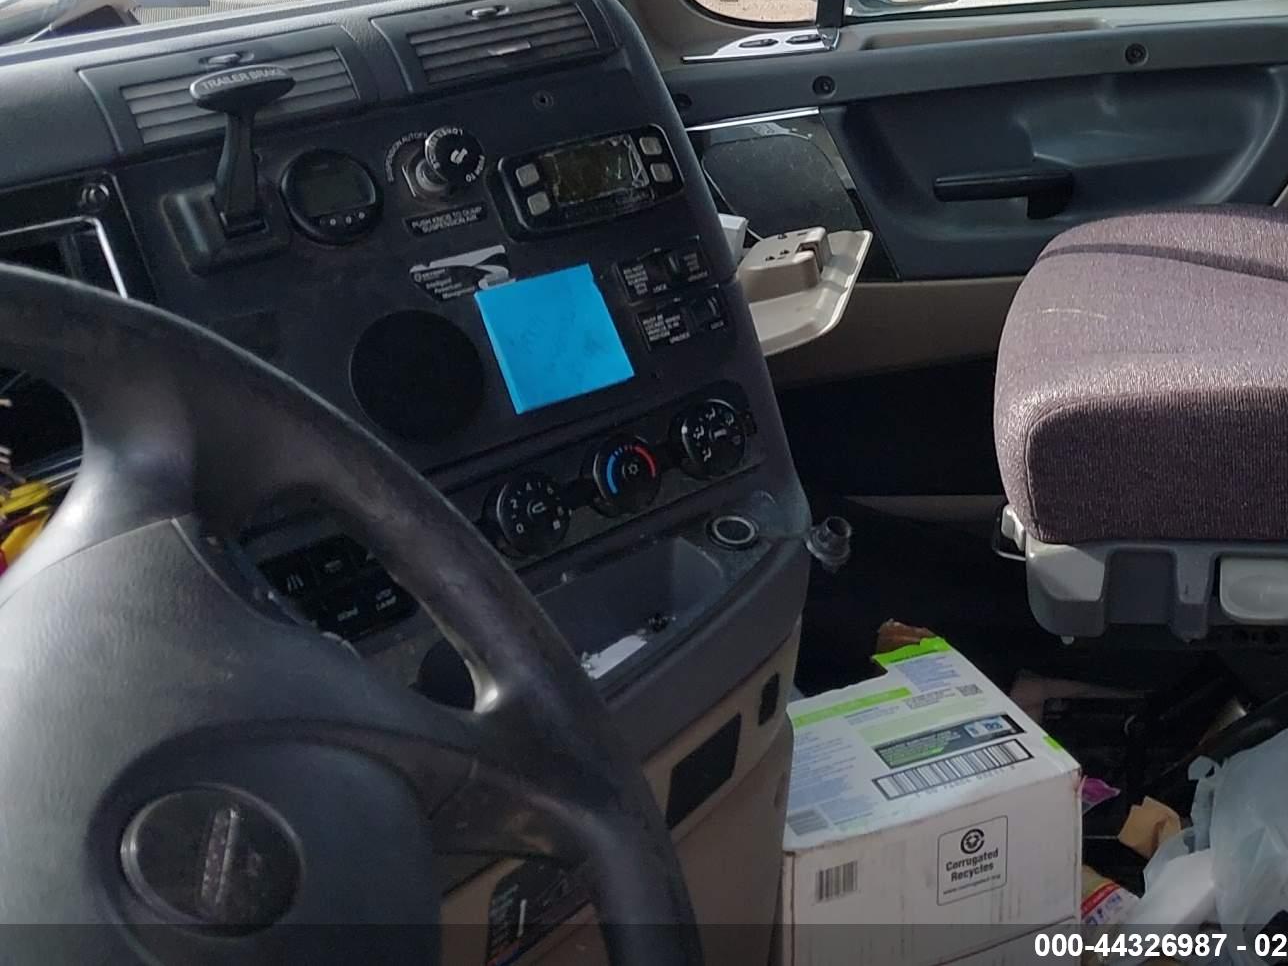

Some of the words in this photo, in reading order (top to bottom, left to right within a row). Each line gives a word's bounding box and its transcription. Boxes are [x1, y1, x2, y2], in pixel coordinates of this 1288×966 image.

[202, 73, 249, 91] TRAILER
[248, 67, 287, 79] BRAKE
[945, 847, 999, 871] Corrugated
[950, 862, 994, 882] Recycles
